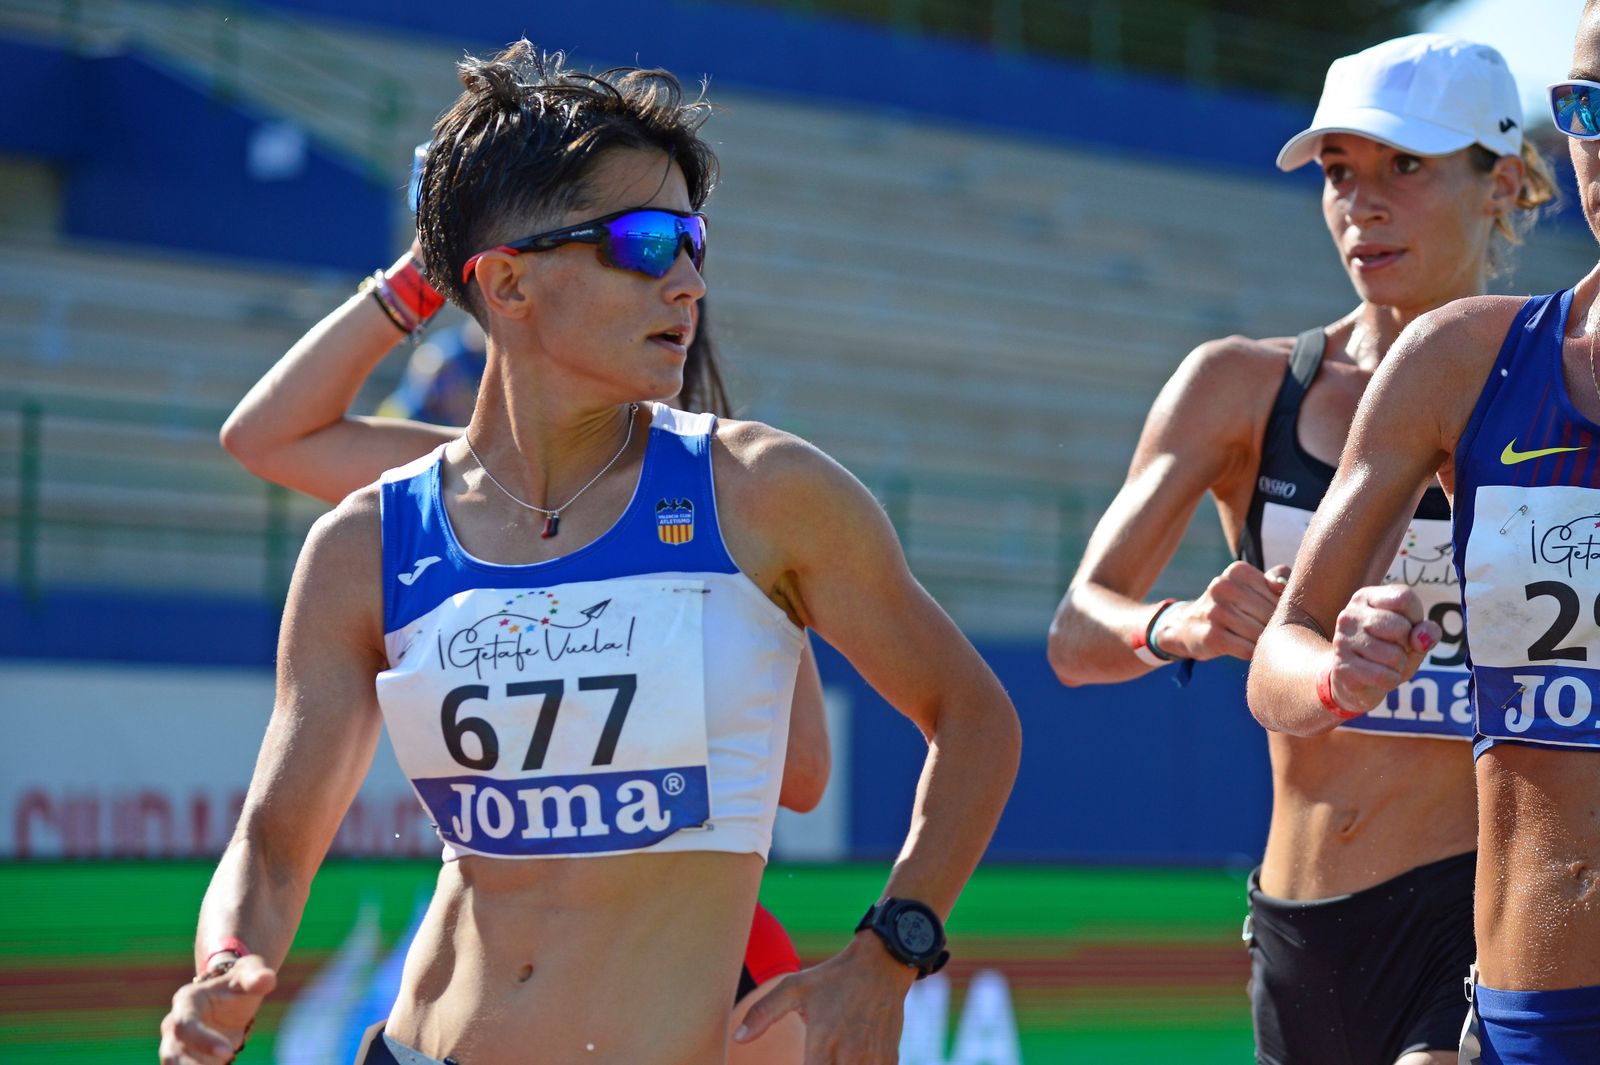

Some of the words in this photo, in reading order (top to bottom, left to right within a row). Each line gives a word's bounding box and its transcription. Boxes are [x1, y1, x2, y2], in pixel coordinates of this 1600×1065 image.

[544, 617, 635, 662] Vuela!
[1525, 580, 1600, 661] 2
[440, 673, 638, 772] 677
[1504, 674, 1600, 734] Jo
